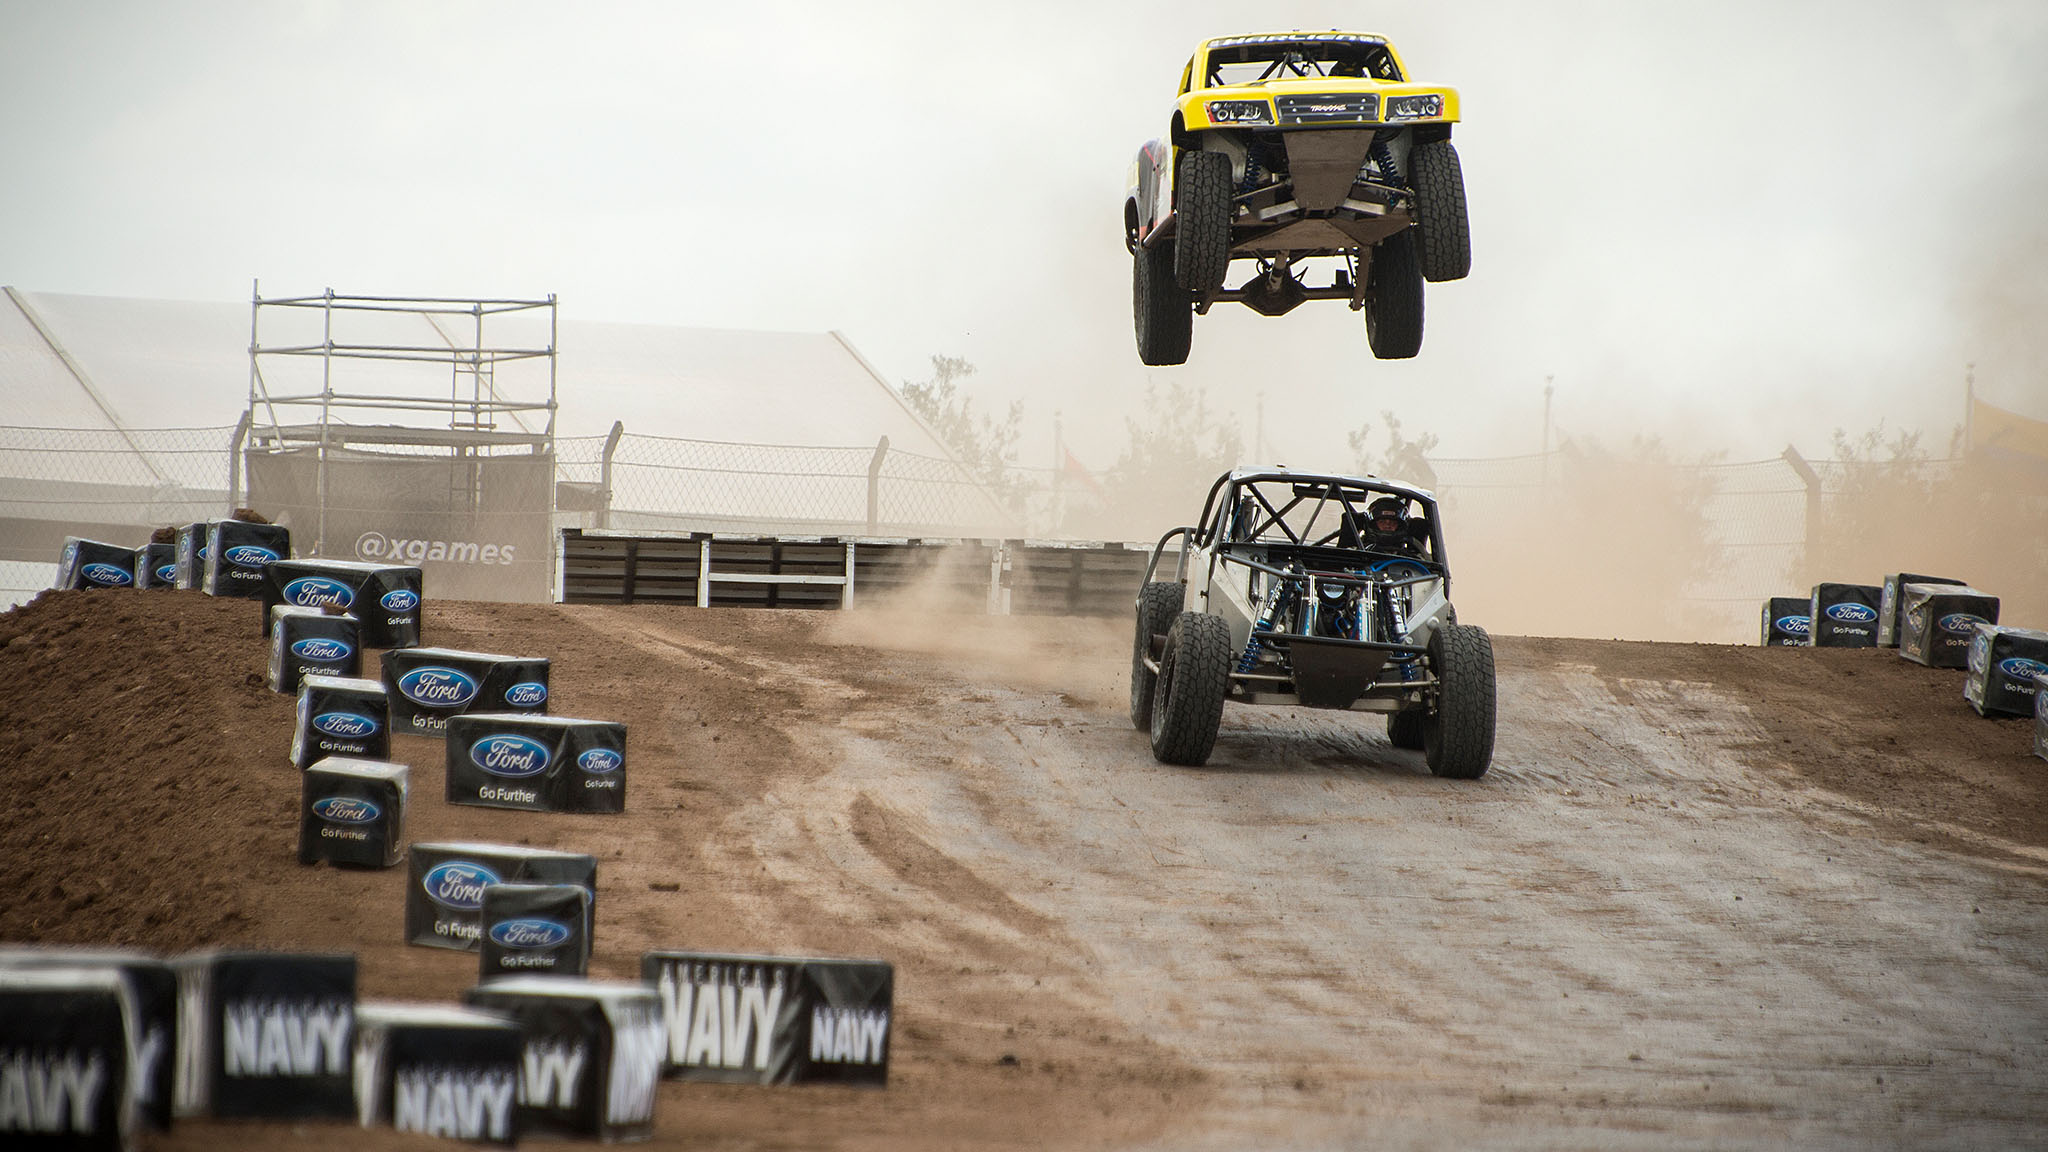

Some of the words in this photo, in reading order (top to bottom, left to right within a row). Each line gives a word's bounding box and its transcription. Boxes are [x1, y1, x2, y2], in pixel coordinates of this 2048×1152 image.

[234, 548, 270, 565] Ford
[354, 530, 516, 566] @xgames
[90, 566, 122, 584] Ford
[231, 571, 241, 579] Go
[296, 581, 342, 606] Ford
[388, 592, 411, 608] Ford
[1836, 605, 1868, 620] Ford
[1785, 617, 1810, 631] For
[1833, 626, 1844, 634] Go
[1844, 627, 1870, 636] Further
[301, 641, 339, 658] Ford
[1783, 638, 1793, 646] Go
[1946, 639, 1957, 647] Go
[298, 666, 311, 675] Go
[311, 667, 340, 676] Further
[414, 671, 463, 701] Ford
[512, 686, 541, 703] Ford
[2005, 683, 2016, 691] Go
[323, 715, 364, 734] Ford
[412, 714, 426, 728] Go
[320, 741, 333, 750] Go
[333, 743, 364, 753] Further
[485, 740, 535, 770] Ford
[586, 752, 612, 769] Ford
[585, 779, 595, 788] Go
[595, 780, 616, 788] Further
[479, 786, 495, 799] Go
[496, 788, 536, 803] Further
[325, 800, 368, 820] Ford
[321, 828, 334, 838] Go
[335, 830, 368, 841] Further
[439, 867, 488, 903] Ford
[434, 920, 448, 936] Go
[503, 922, 553, 943] Ford
[501, 956, 516, 967] Go
[517, 955, 556, 968] Further
[658, 978, 784, 1072] NAVY
[223, 1010, 350, 1075] NAVY
[811, 1015, 888, 1065] NAVY
[0, 1064, 104, 1133] AVY
[394, 1077, 515, 1139] NAVY
